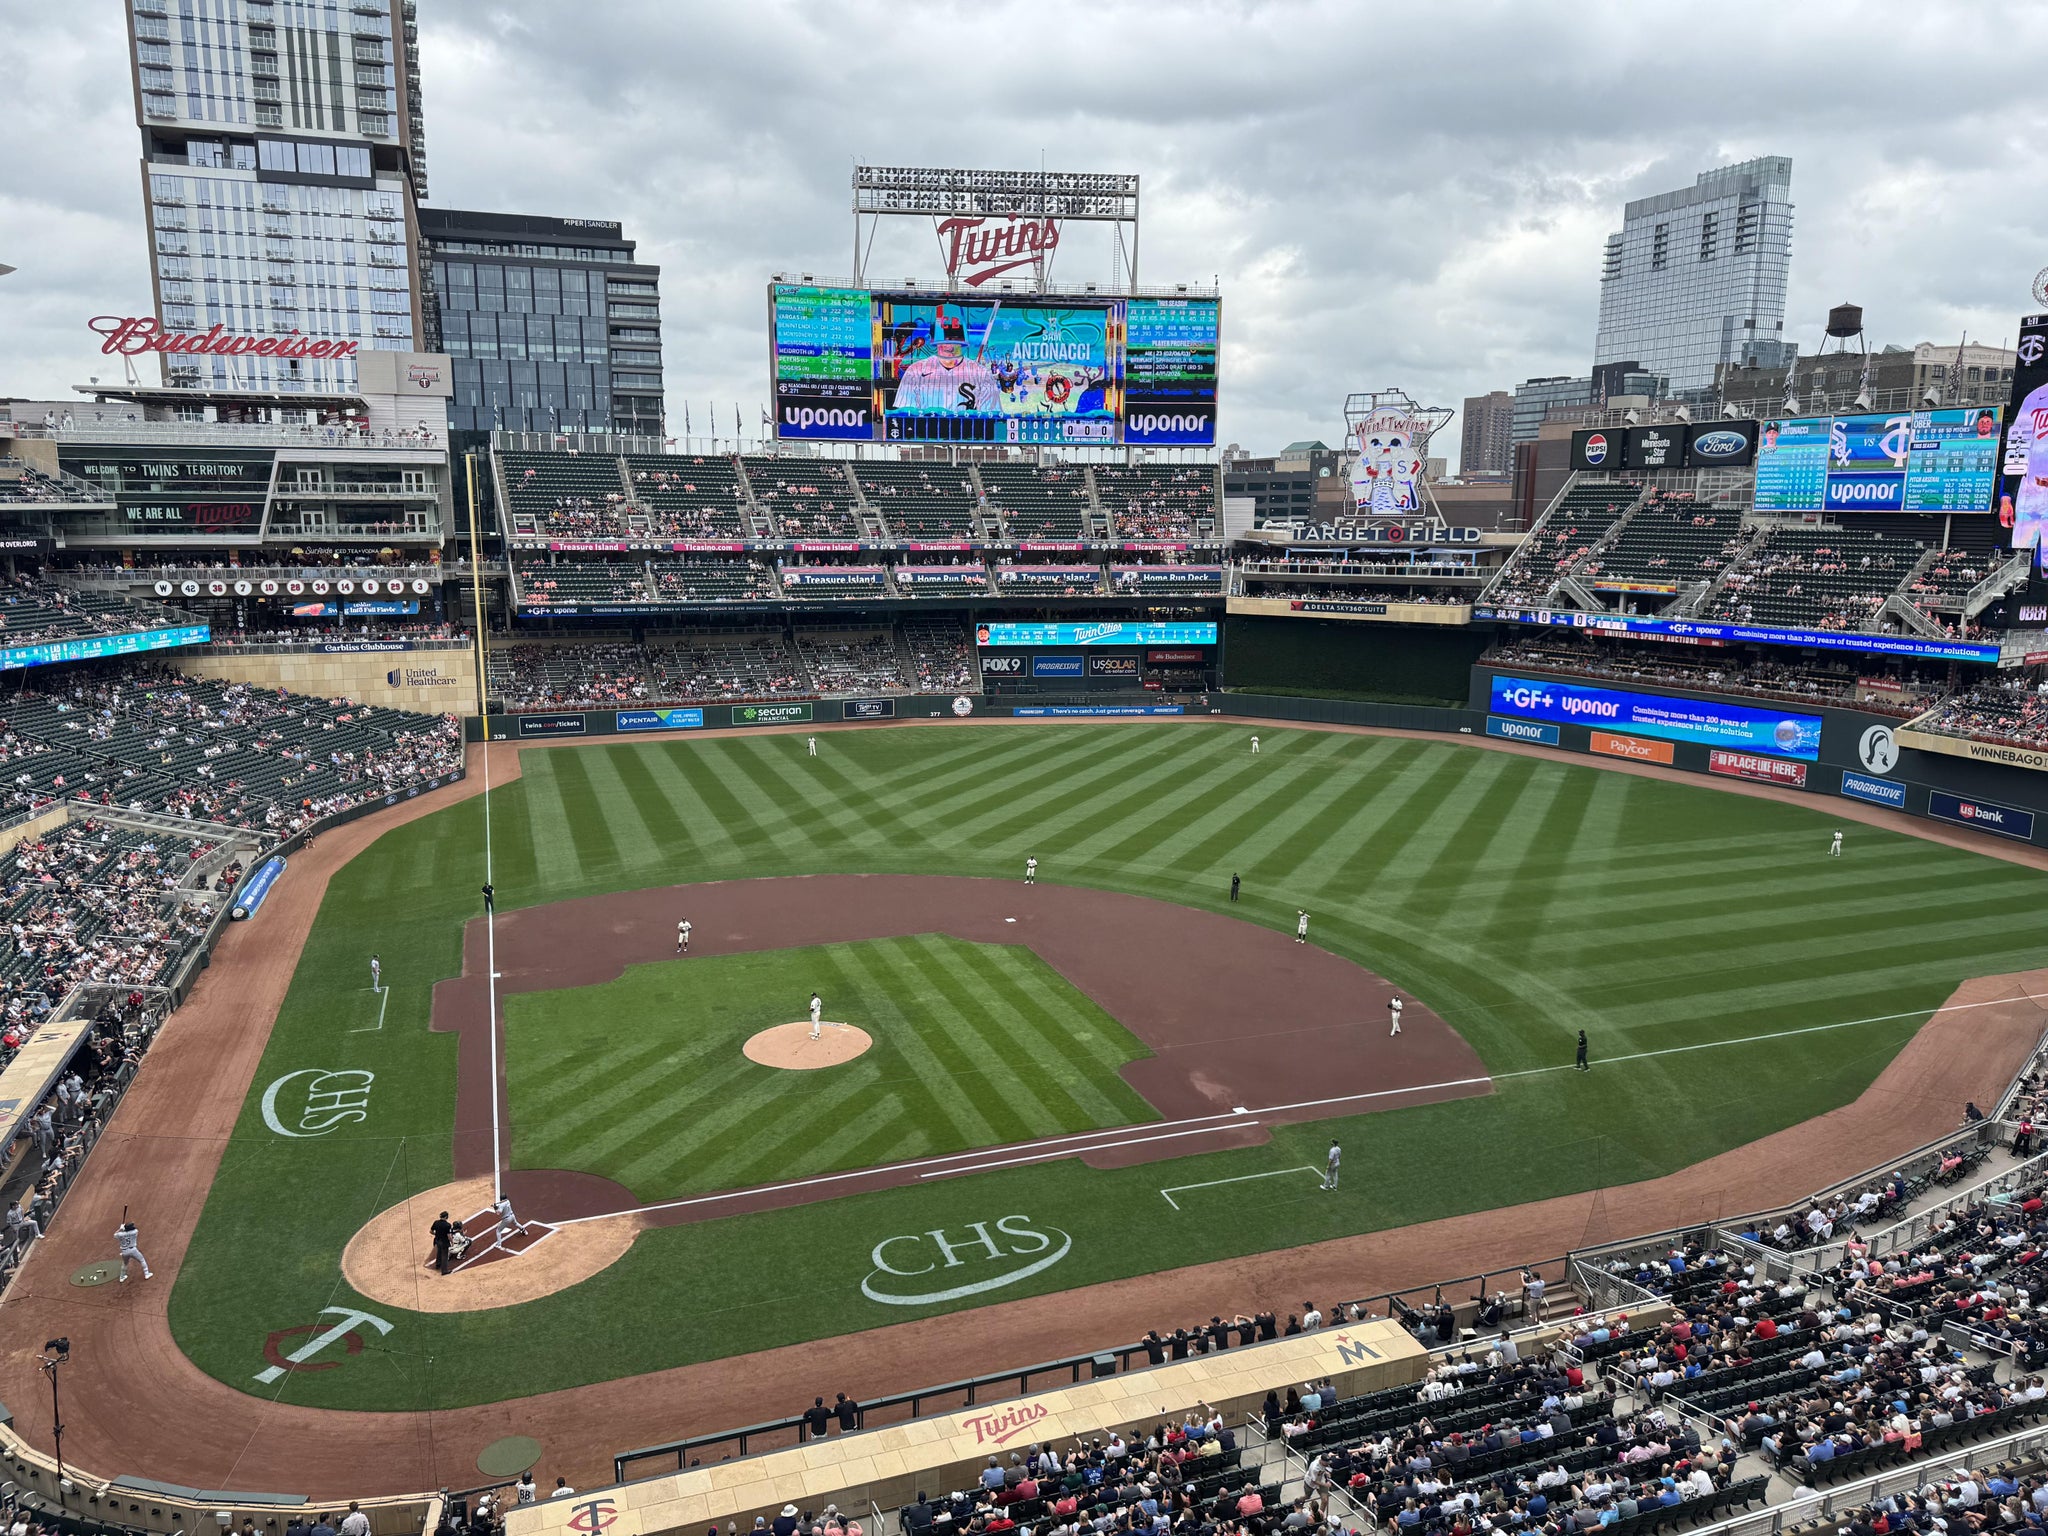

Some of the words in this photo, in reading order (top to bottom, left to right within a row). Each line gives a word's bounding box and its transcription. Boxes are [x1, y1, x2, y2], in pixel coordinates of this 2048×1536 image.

[564, 219, 584, 227] PIPER
[587, 220, 618, 229] SANDLER
[937, 211, 1060, 276] Twins
[88, 316, 358, 359] Budweiser
[1013, 342, 1090, 360] ANTONACCI
[786, 406, 866, 430] uponor
[1130, 414, 1208, 435] uponor
[1355, 417, 1384, 436] Win!
[1385, 414, 1433, 432] Twins!
[1913, 420, 1931, 428] OBER
[1963, 410, 1977, 426] 17
[1068, 426, 1073, 435] 0
[1085, 426, 1090, 435] 0
[1102, 426, 1107, 436] 0
[1642, 439, 1670, 447] Minnesota
[1704, 436, 1734, 452] Ford
[1644, 456, 1665, 464] Tribune
[1653, 448, 1666, 456] Star
[84, 465, 119, 474] WELCOME
[141, 465, 179, 477] TWINS
[186, 465, 244, 476] TERRITORY
[1398, 460, 1407, 474] S
[1831, 483, 1898, 503] uponor
[126, 508, 142, 519] WE
[146, 507, 163, 519] ARE
[166, 507, 182, 519] ALL
[187, 503, 252, 525] Twins
[1294, 527, 1385, 541] TARGET
[1409, 528, 1481, 541] FIELD
[805, 575, 847, 583] Treasure
[848, 575, 876, 583] Island
[160, 584, 167, 592] W
[185, 584, 196, 593] 42
[212, 584, 223, 593] 36
[240, 584, 246, 592] 7
[265, 584, 274, 592] 10
[290, 584, 300, 592] 28
[316, 583, 326, 591] 34
[341, 583, 350, 591] 14
[368, 583, 373, 591] 6
[391, 583, 400, 591] 29
[1542, 613, 1547, 622] 0
[1577, 615, 1583, 625] 0
[1696, 626, 1722, 635] uponor
[1733, 629, 1768, 640] Combining
[1787, 633, 1802, 642] than
[1817, 637, 1835, 645] years
[1846, 639, 1872, 648] trusted
[1873, 641, 1914, 651] experience
[1924, 644, 1942, 653] flow
[1944, 646, 1980, 656] solutions
[1605, 630, 1637, 638] UNIVERSAL
[1640, 632, 1664, 641] SPORTS
[1666, 636, 1698, 644] AUCTIONS
[325, 644, 360, 652] Carbliss
[361, 643, 404, 651] Clubhouse
[406, 669, 437, 677] United
[982, 659, 1008, 671] FOX
[1012, 659, 1020, 671] 9
[406, 677, 457, 687] Healthcare
[758, 706, 801, 715] securian
[1561, 696, 1620, 717] uponor
[1632, 706, 1669, 717] Combining
[1689, 712, 1705, 722] than
[1706, 714, 1718, 723] 200
[1719, 718, 1738, 728] years
[1740, 719, 1748, 728] of
[525, 721, 580, 729] twins.com/tickets
[1502, 722, 1542, 738] uponor
[1632, 715, 1656, 724] trusted
[1657, 717, 1693, 730] experience
[1695, 722, 1702, 730] in
[1703, 723, 1718, 733] flow
[1720, 726, 1753, 738] solutions
[1611, 741, 1651, 756] Paycor
[1970, 746, 2042, 766] WINNEBAGO
[1728, 755, 1756, 770] PLACE
[1757, 760, 1771, 772] LIKE
[1772, 762, 1797, 776] HERE
[1845, 779, 1903, 800] PROGRESSIVE
[299, 1069, 375, 1130] CHS
[872, 1215, 1050, 1275] CHS
[962, 1403, 1048, 1444] Twins
